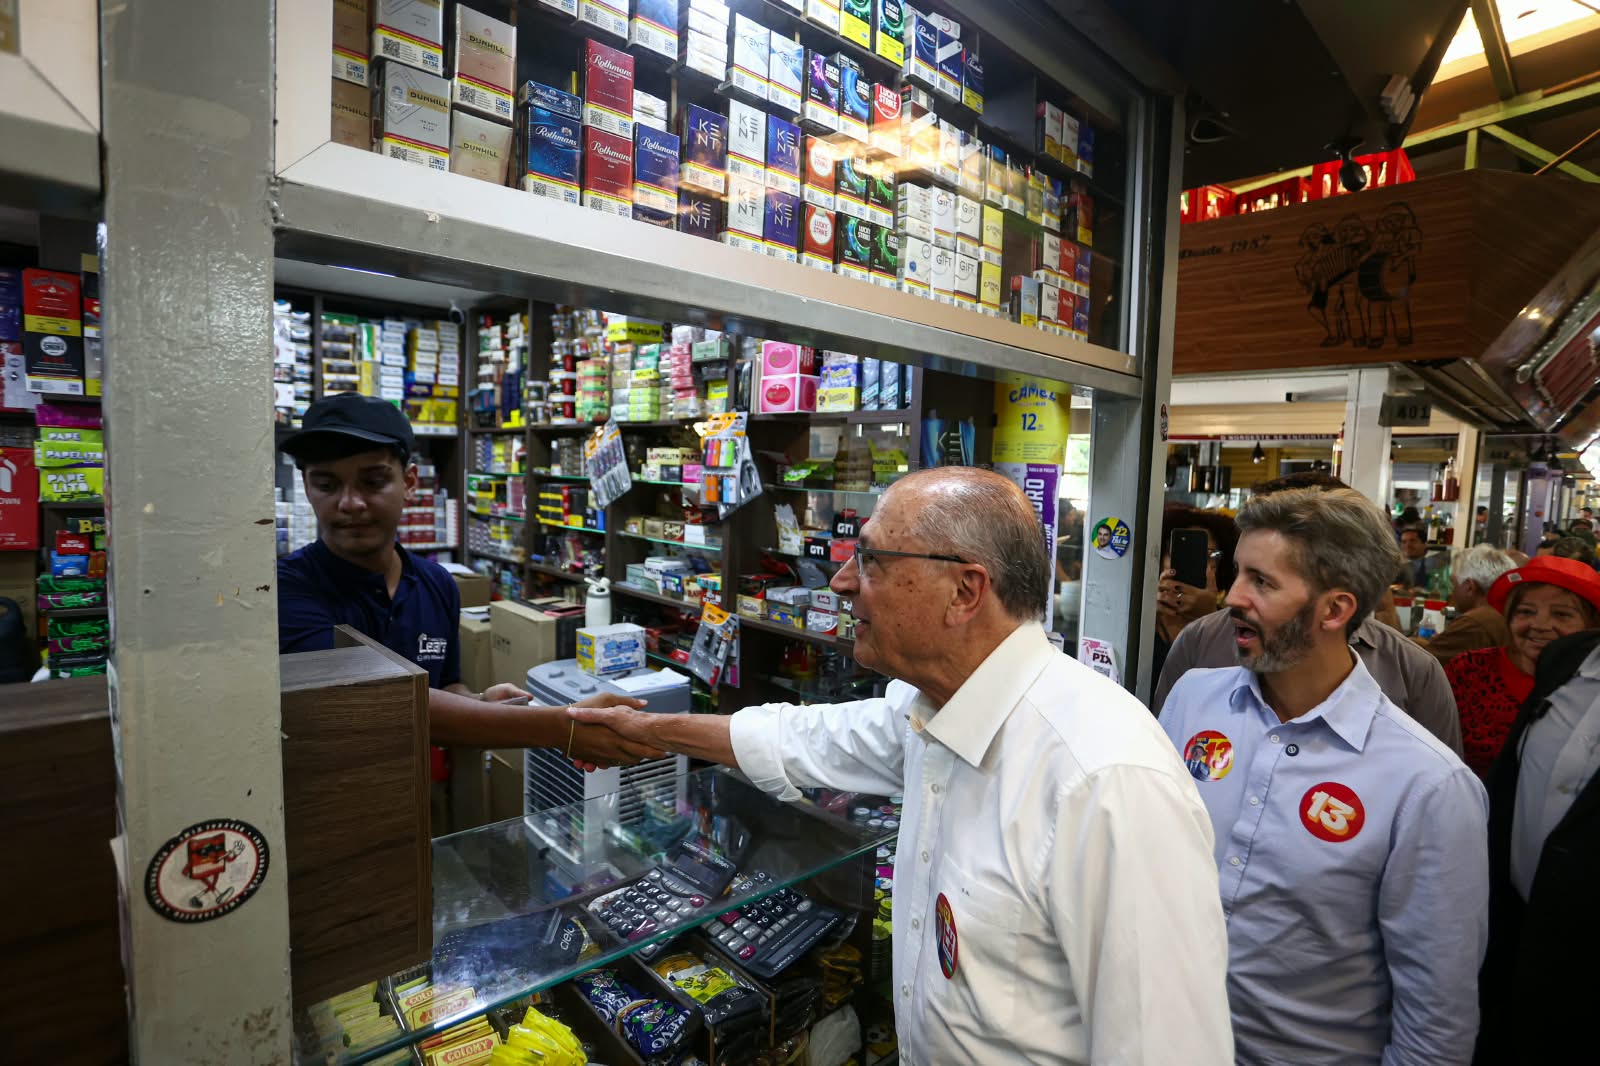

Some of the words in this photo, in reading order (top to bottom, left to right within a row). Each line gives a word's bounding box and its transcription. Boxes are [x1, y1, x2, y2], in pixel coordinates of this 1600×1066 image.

[469, 35, 505, 55] DUNHILL
[591, 53, 633, 78] Rothmans
[410, 91, 448, 108] DUNHILL
[880, 85, 897, 101] LUCKY
[879, 95, 898, 109] STRIKE
[535, 126, 578, 146] Rothmans
[463, 142, 498, 158] DUNHILL
[590, 140, 632, 162] Rothmans
[640, 136, 680, 158] Rothmans
[936, 195, 952, 209] GIFT
[962, 203, 977, 214] GIFT
[814, 220, 828, 230] LUCKY
[814, 227, 828, 238] STRIKE
[936, 254, 952, 267] GIFT
[960, 261, 975, 272] GIFT
[1009, 386, 1057, 404] CAMEL
[1021, 413, 1037, 431] 12
[48, 432, 80, 441] PAPE
[47, 473, 85, 484] PAPE
[837, 522, 854, 536] GTI
[1115, 527, 1128, 536] 22
[810, 545, 824, 556] GTI
[1092, 652, 1112, 666] PIX
[1206, 742, 1233, 770] 13
[1307, 790, 1358, 837] 13
[560, 924, 576, 951] cielo
[446, 1039, 489, 1061] COLOMY
